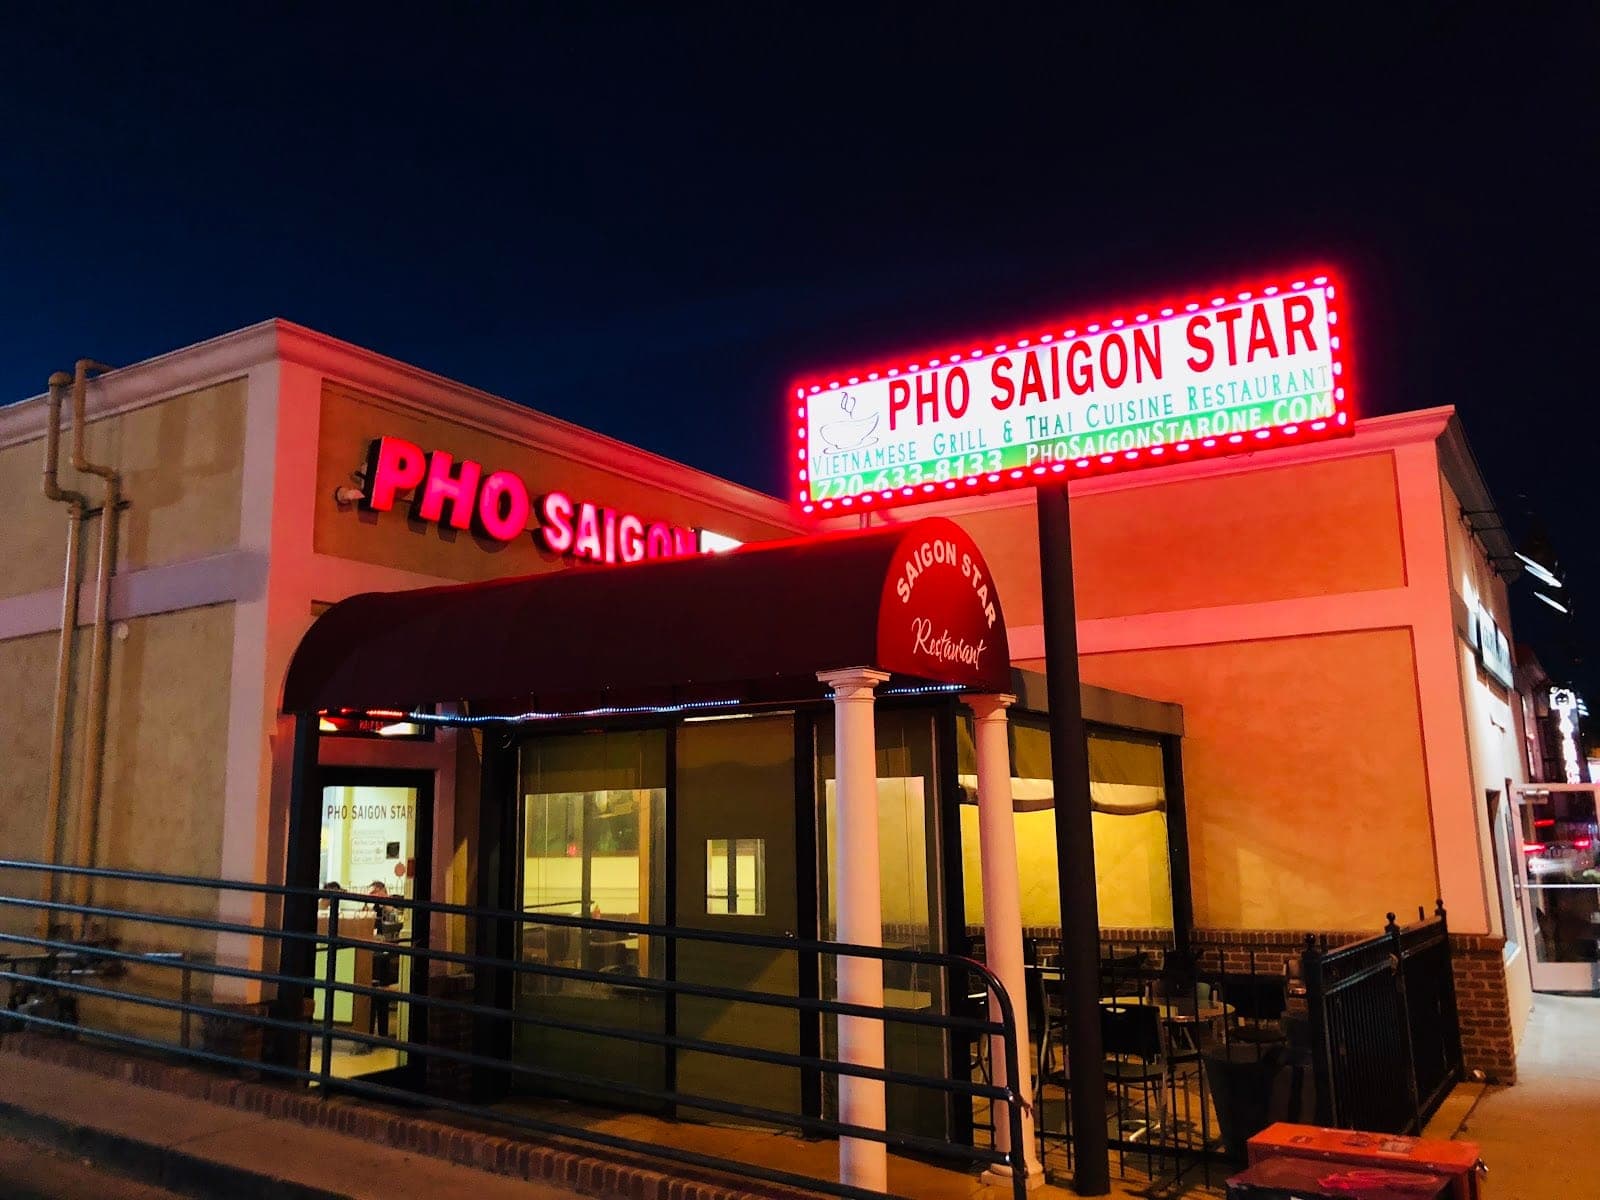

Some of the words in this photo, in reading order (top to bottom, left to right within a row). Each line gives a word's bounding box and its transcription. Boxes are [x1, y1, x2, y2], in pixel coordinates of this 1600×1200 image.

[888, 366, 970, 430] PHO
[990, 325, 1163, 410] SAIGON
[1186, 294, 1318, 373] STAR
[812, 441, 917, 475] VIETNAMESE
[933, 428, 987, 455] GRILL
[1002, 420, 1014, 444] &
[1026, 412, 1073, 439] THAI
[1086, 394, 1174, 428] CUISINE
[1187, 365, 1328, 411] RESTAURANT
[370, 436, 529, 541] PHO
[816, 449, 1004, 501] 720-633-8133
[896, 539, 957, 604] SAIGON
[961, 553, 997, 629] STAR
[911, 617, 988, 670] Restaurant
[327, 805, 348, 819] PHO
[351, 805, 387, 819] SAIGON
[390, 805, 414, 819] STAR
